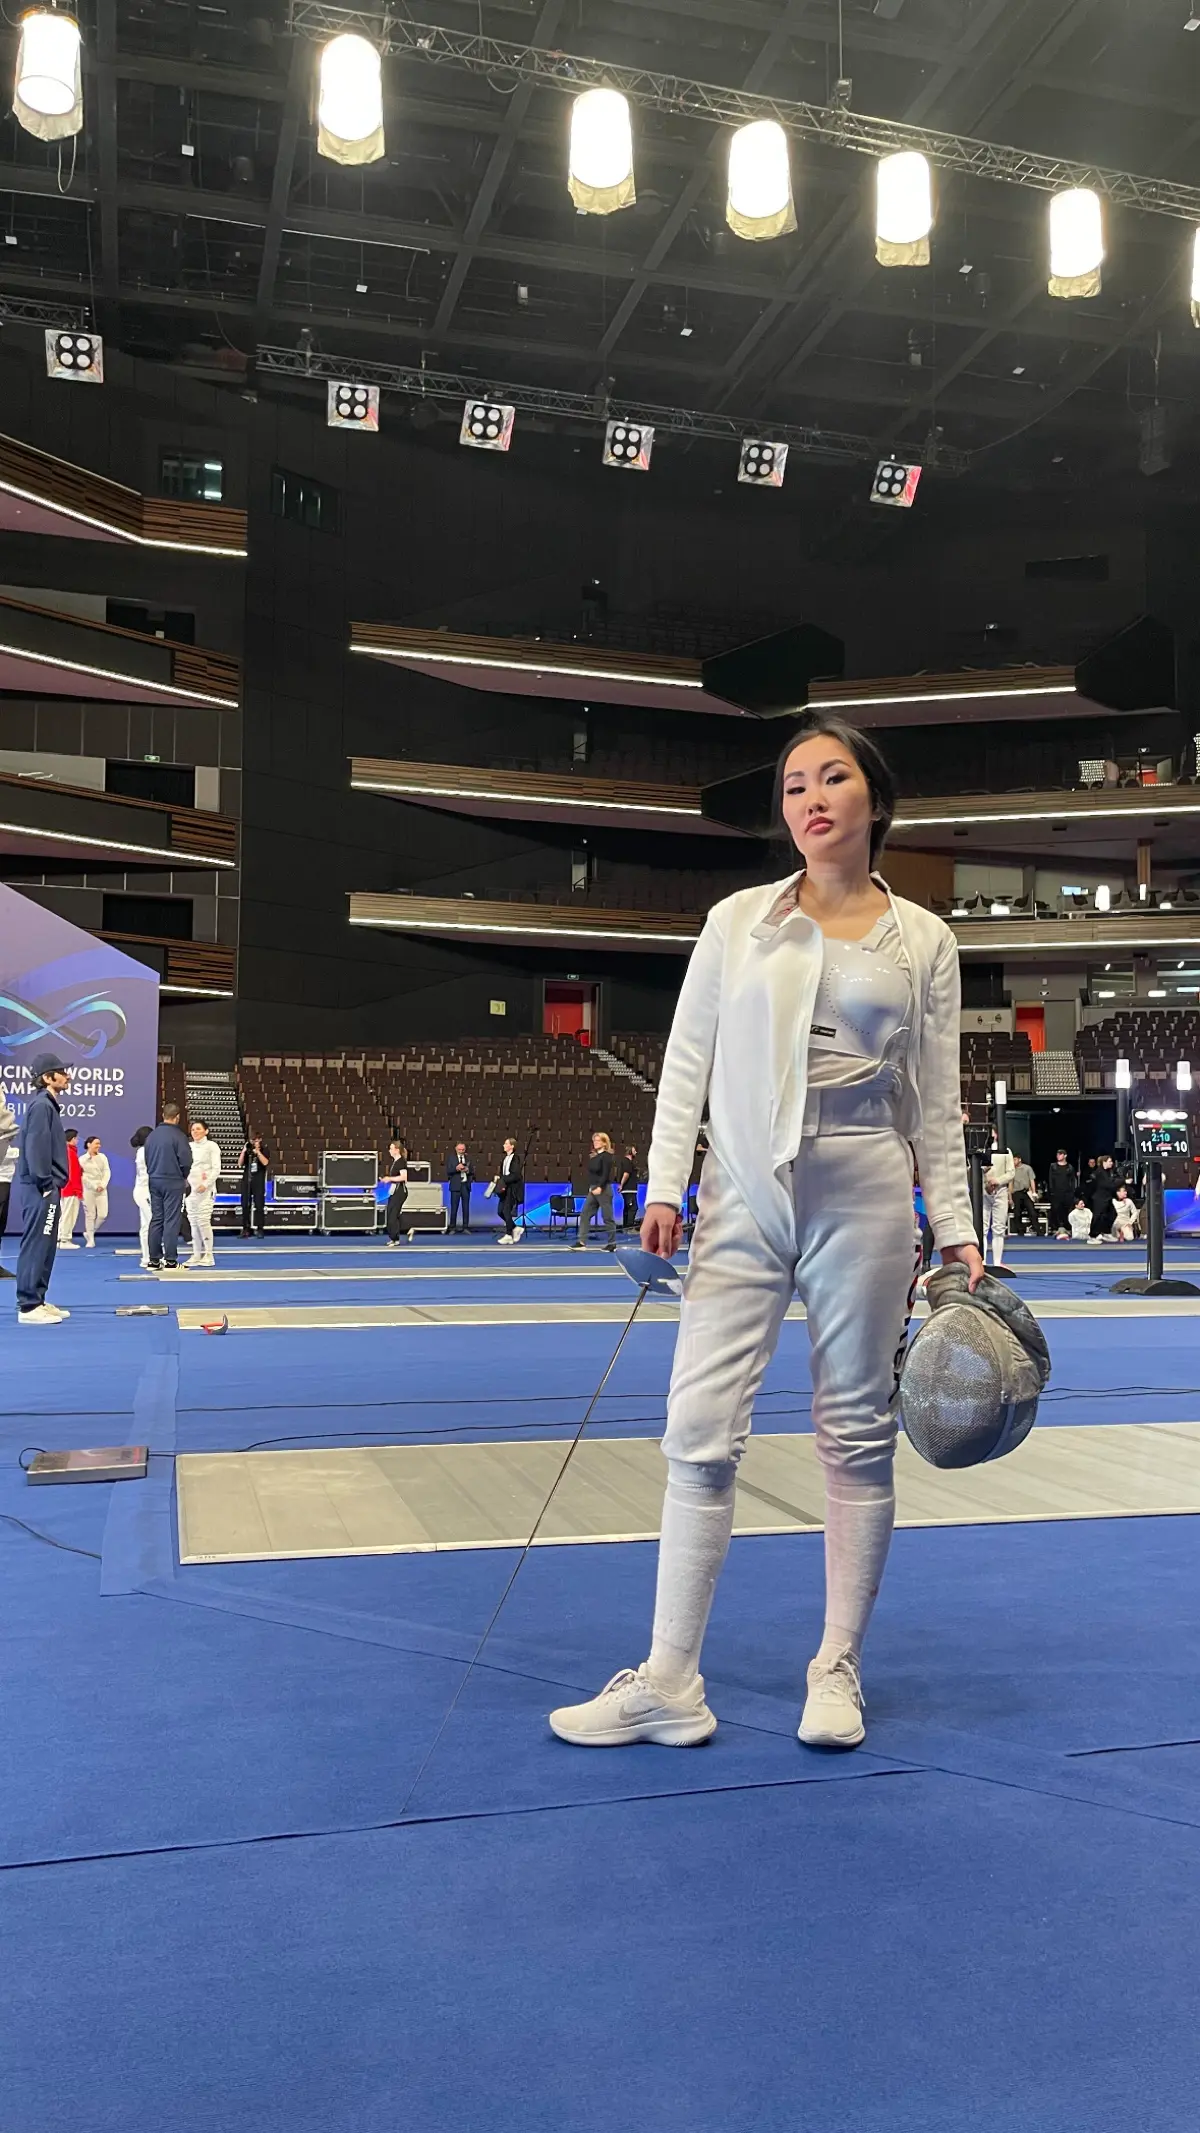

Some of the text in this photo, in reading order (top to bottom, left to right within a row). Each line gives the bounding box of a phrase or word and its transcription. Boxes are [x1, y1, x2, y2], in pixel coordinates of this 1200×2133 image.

[64, 1067, 124, 1081] WORLD
[60, 1103, 97, 1117] 2025
[1151, 1133, 1170, 1142] 2:10
[1140, 1141, 1153, 1152] 11
[1174, 1141, 1188, 1153] 10
[43, 1203, 57, 1235] FRANCE
